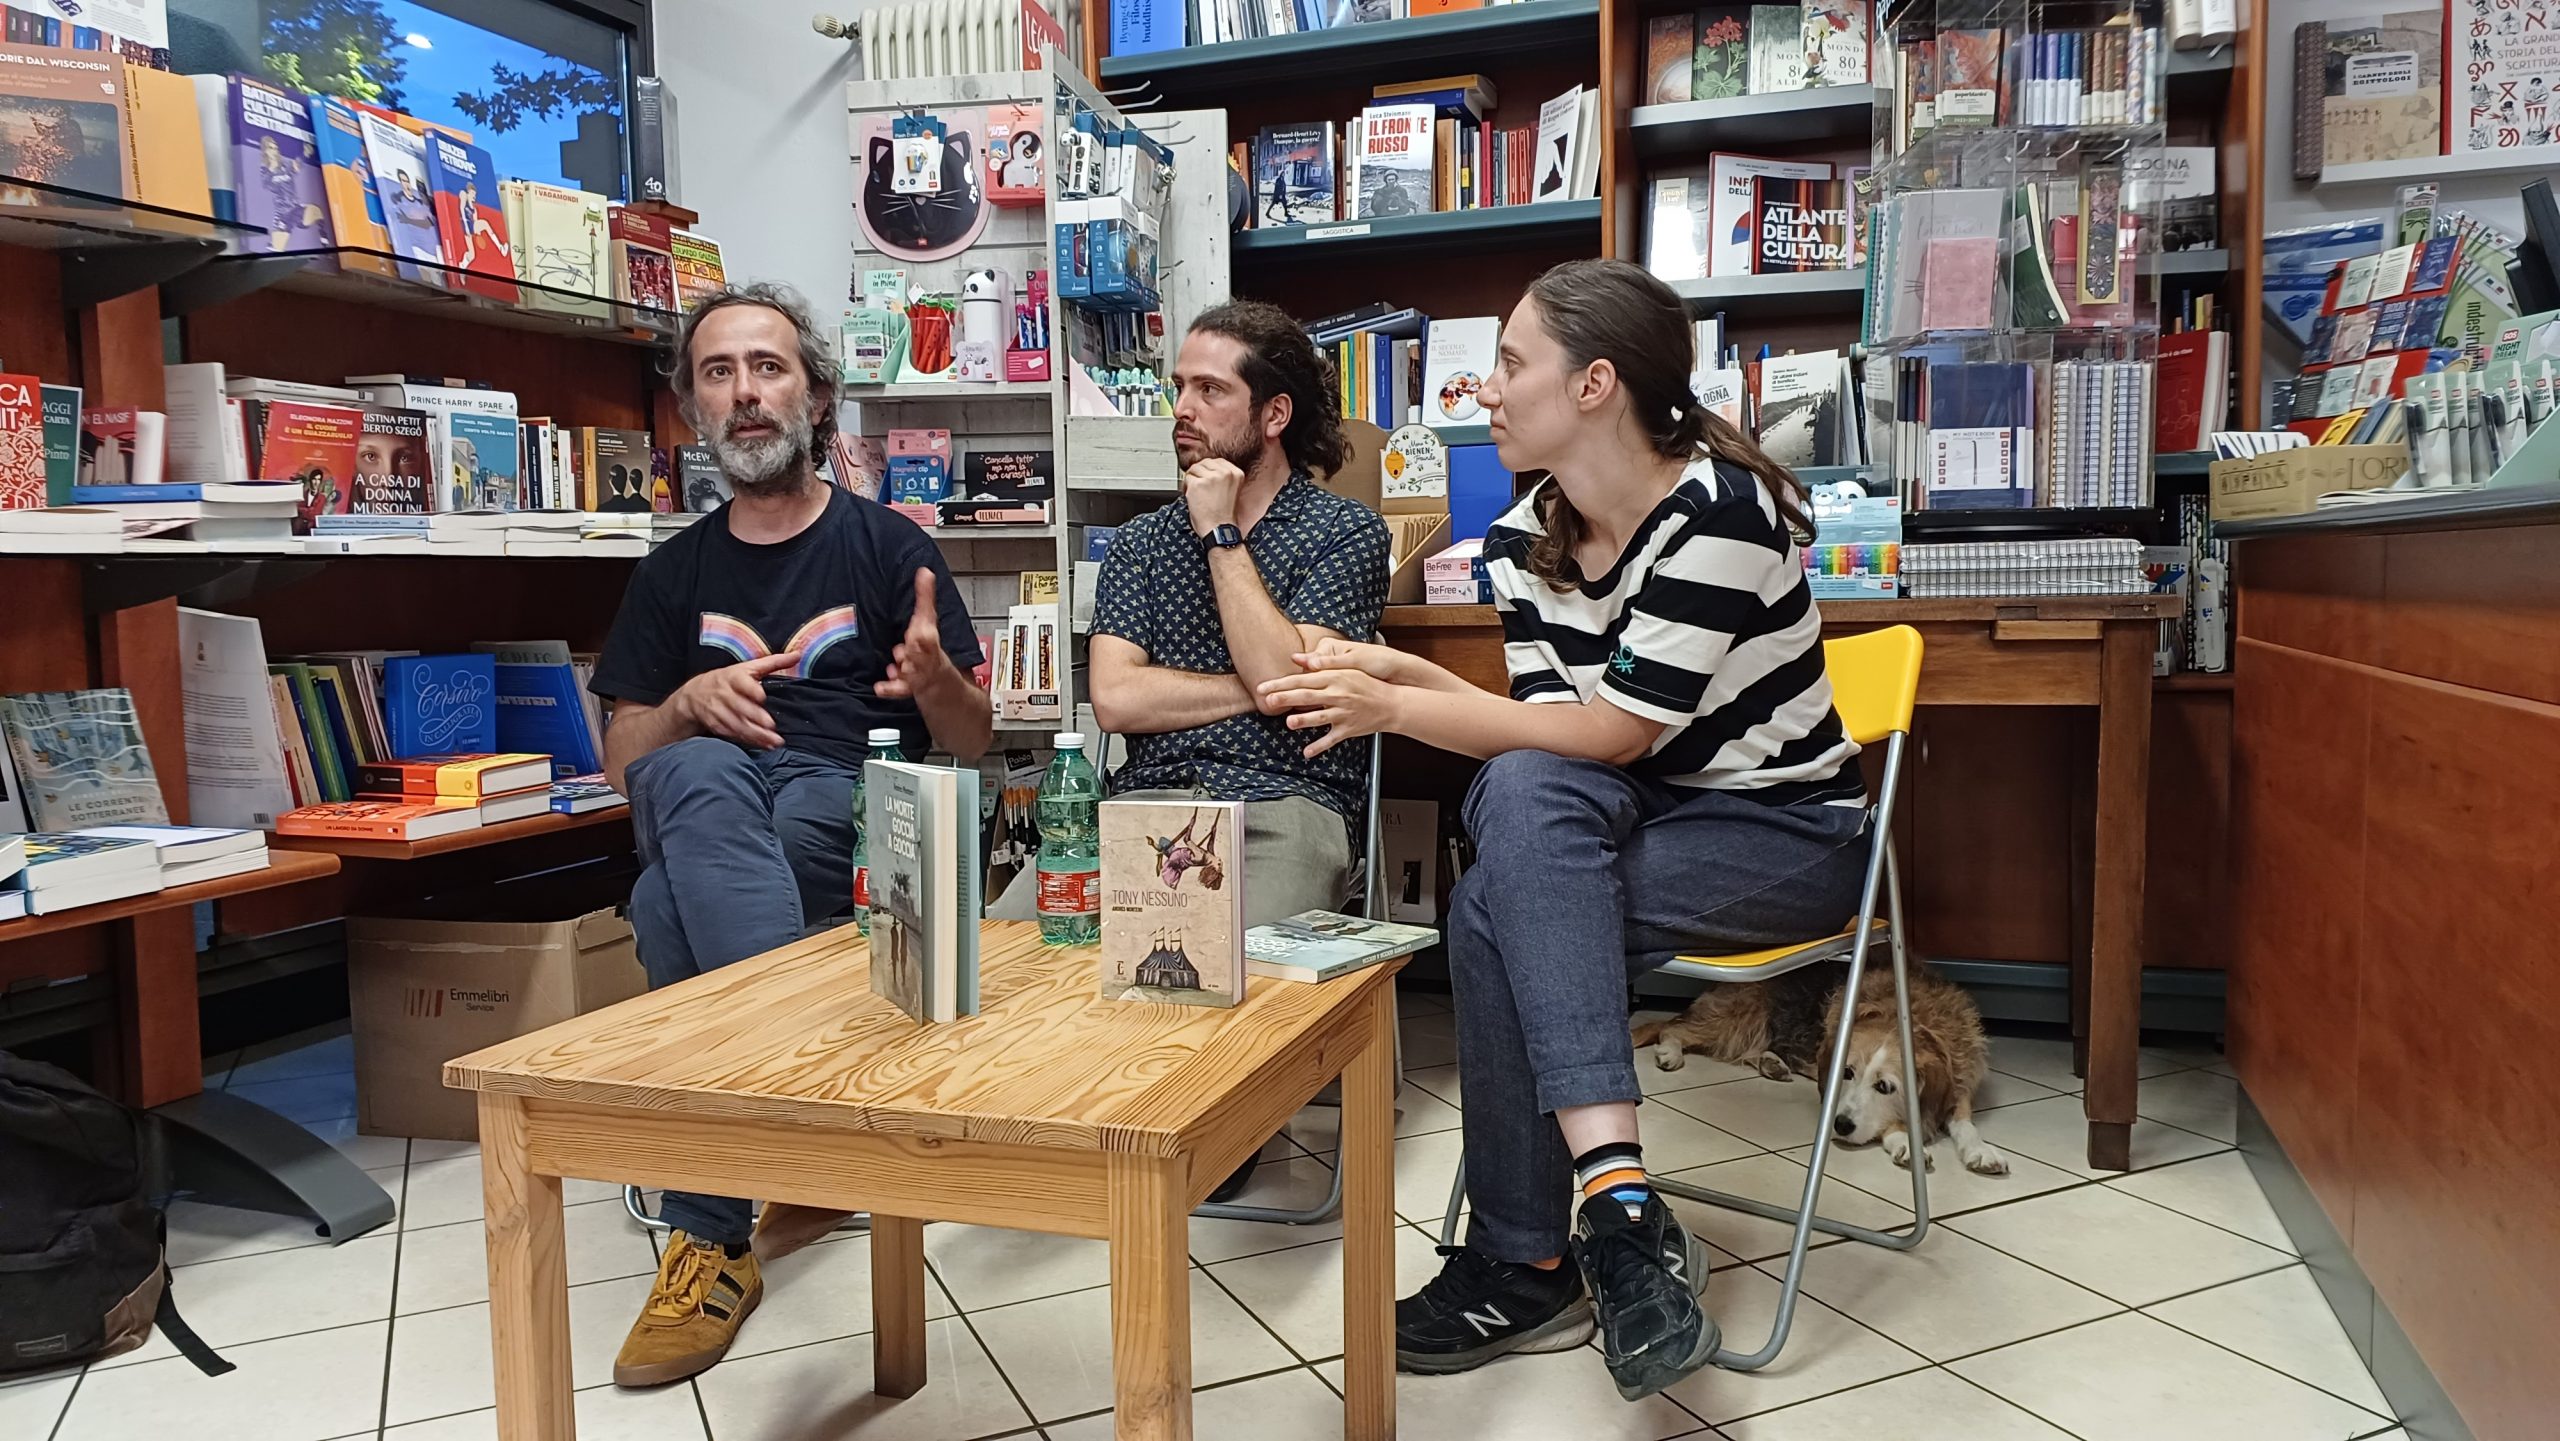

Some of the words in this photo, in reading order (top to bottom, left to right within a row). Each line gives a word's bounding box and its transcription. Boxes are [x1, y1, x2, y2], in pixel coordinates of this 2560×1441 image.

[2505, 36, 2519, 46] LA
[2497, 47, 2536, 60] STORIA
[26, 56, 47, 66] DAL
[49, 58, 111, 72] WISCONSIN
[1839, 56, 1856, 69] 80
[2353, 76, 2411, 85] EGITTOLOGI
[1369, 119, 1379, 136] IL
[1368, 136, 1409, 154] RUSSO
[539, 192, 579, 204] VAGAMONDI
[1763, 206, 1847, 225] ATLANTE
[1763, 223, 1822, 242] DELLA
[1763, 241, 1847, 260] CULTURA
[2503, 331, 2518, 341] SOS
[2497, 341, 2521, 352] NIGHT
[41, 401, 71, 415] AGGI
[411, 396, 442, 406] PRINCE
[445, 398, 473, 409] HARRY
[478, 401, 503, 410] SPARE
[398, 416, 420, 426] PETIT
[44, 448, 70, 460] Pinto
[355, 474, 365, 485] A
[369, 474, 404, 486] CASA
[407, 474, 420, 487] DI
[365, 488, 413, 501] DONNA
[353, 502, 422, 514] MUSSOLINI
[68, 804, 82, 812] LE
[71, 806, 146, 821] SOTTERRANEE
[885, 795, 893, 813] LA
[893, 798, 915, 820] MORTE
[892, 816, 915, 840] GOCCIA
[888, 833, 893, 850] A
[893, 836, 916, 861] GOCCIA
[1112, 889, 1138, 905] TONY
[1141, 891, 1188, 908] NESSUNO
[450, 988, 510, 1004] Emmelibri
[466, 1003, 495, 1012] Service
[1462, 1303, 1511, 1338] N
